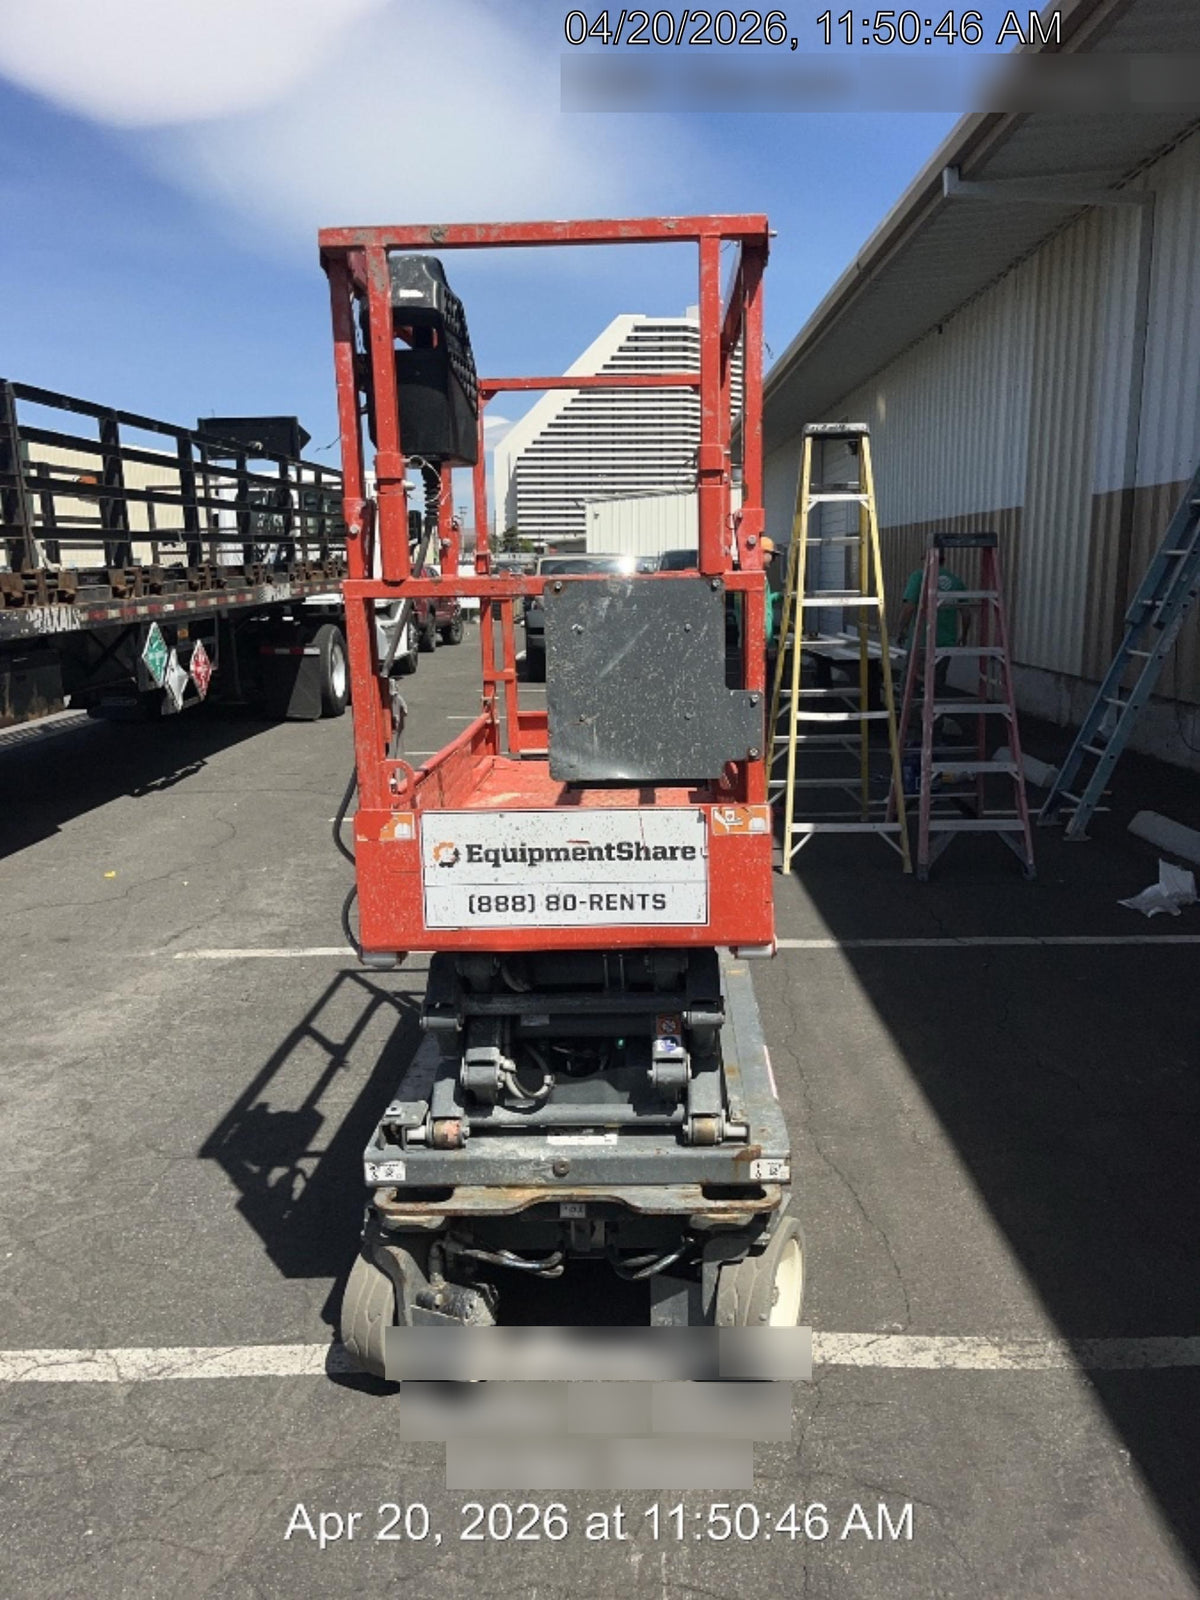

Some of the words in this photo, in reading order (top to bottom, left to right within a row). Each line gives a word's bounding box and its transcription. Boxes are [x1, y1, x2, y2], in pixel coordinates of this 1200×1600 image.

[466, 841, 696, 868] EquipmentShare
[468, 893, 536, 915] (888)
[545, 893, 667, 911] 80-RENTS
